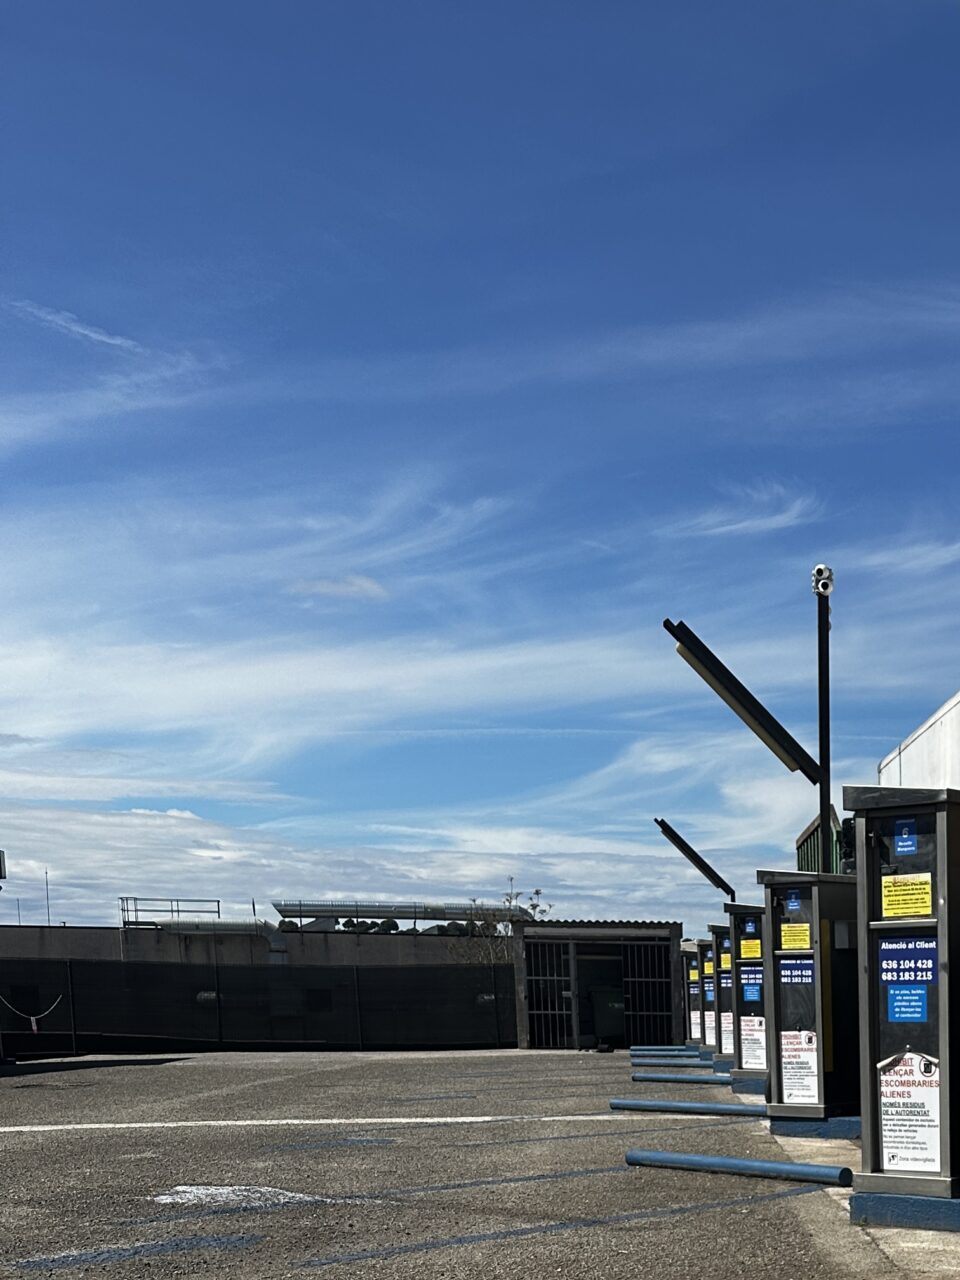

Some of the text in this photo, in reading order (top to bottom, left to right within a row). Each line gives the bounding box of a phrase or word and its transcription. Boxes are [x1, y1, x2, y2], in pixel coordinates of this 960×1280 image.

[902, 827, 910, 838] 6
[881, 940, 936, 950] Atenció al Client
[882, 959, 933, 969] 636 104 428
[881, 971, 933, 981] 683 183 215
[881, 1079, 940, 1088] ESCOMBRARIES
[880, 1090, 912, 1099] ALIENES
